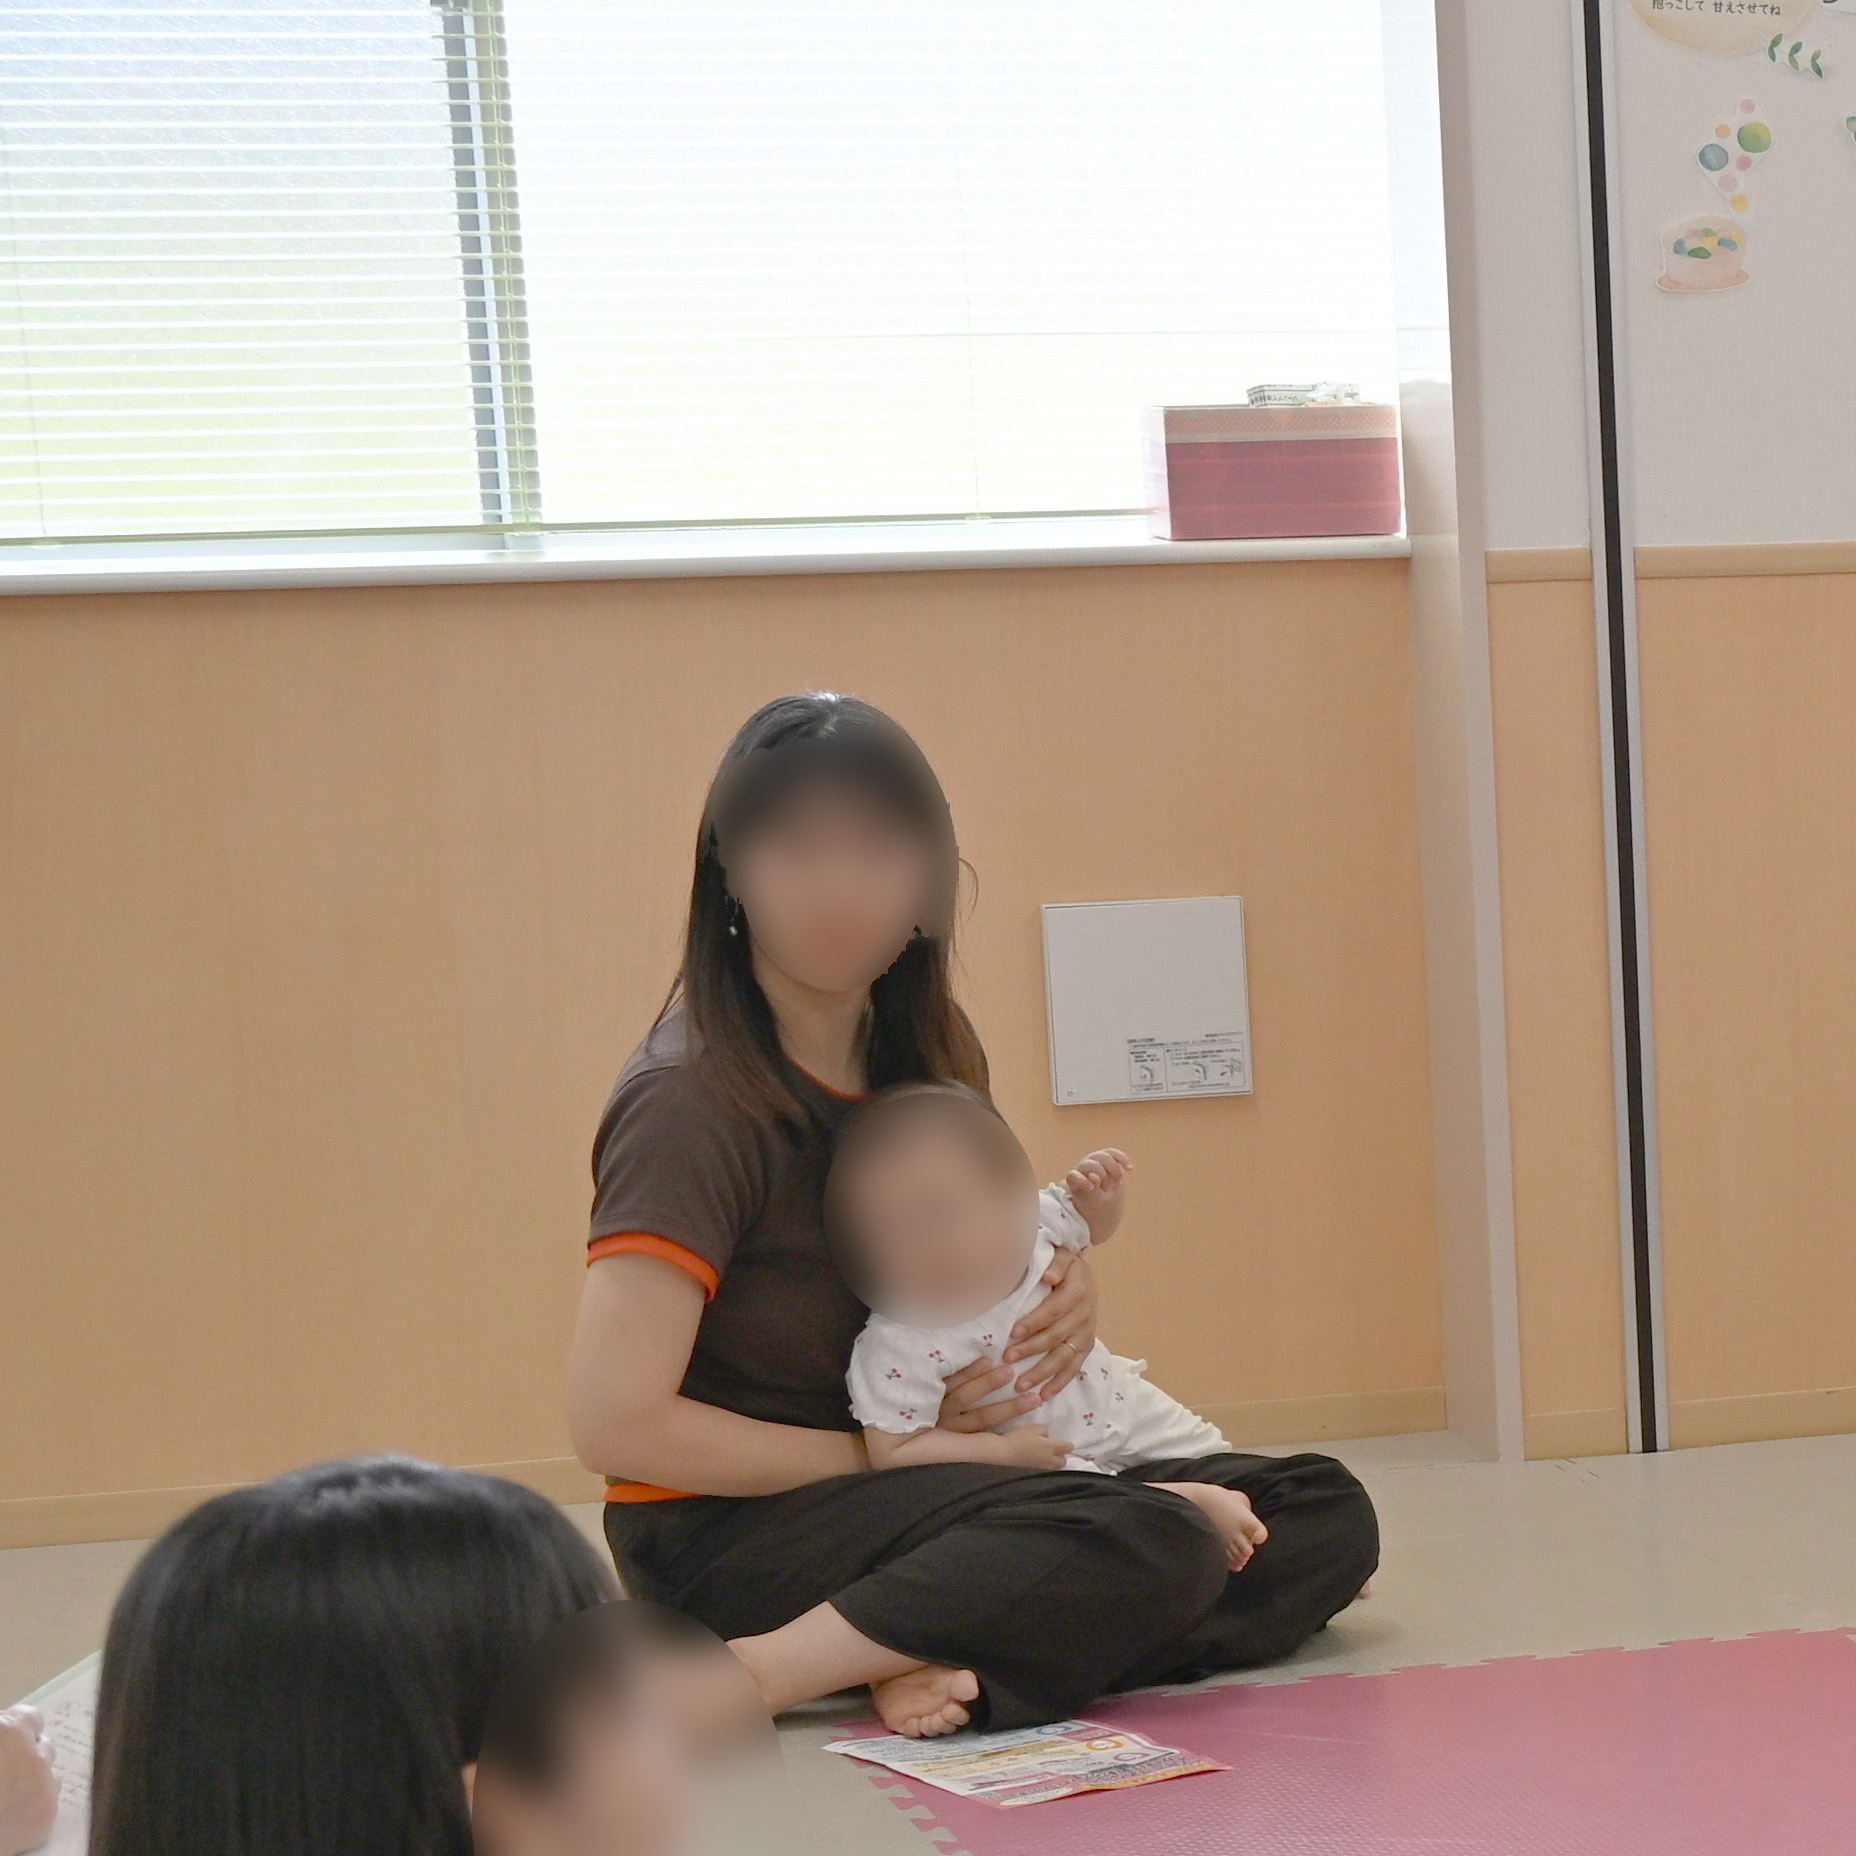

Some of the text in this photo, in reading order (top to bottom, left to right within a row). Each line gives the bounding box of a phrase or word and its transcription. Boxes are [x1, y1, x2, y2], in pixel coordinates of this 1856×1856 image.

[1712, 1, 1782, 16] 甘えさせてね
